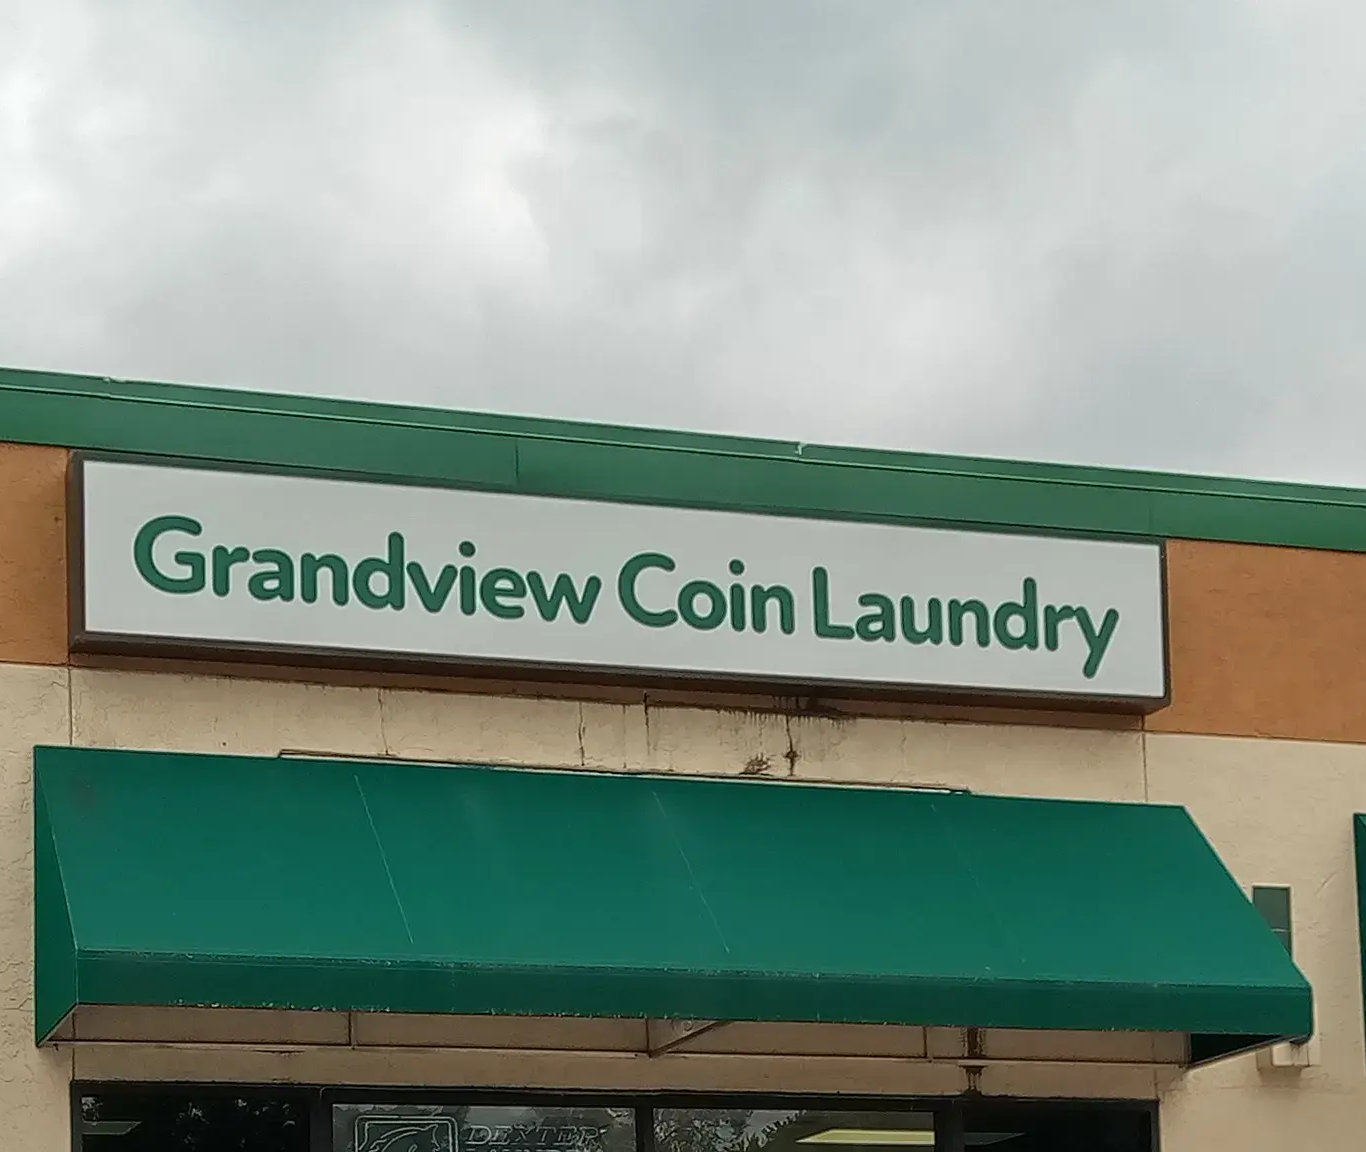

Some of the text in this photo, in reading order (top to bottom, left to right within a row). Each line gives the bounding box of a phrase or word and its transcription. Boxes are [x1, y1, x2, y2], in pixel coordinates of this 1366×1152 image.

[133, 514, 1119, 678] Grandview Coin Laundry
[465, 1125, 599, 1146] DEXTER
